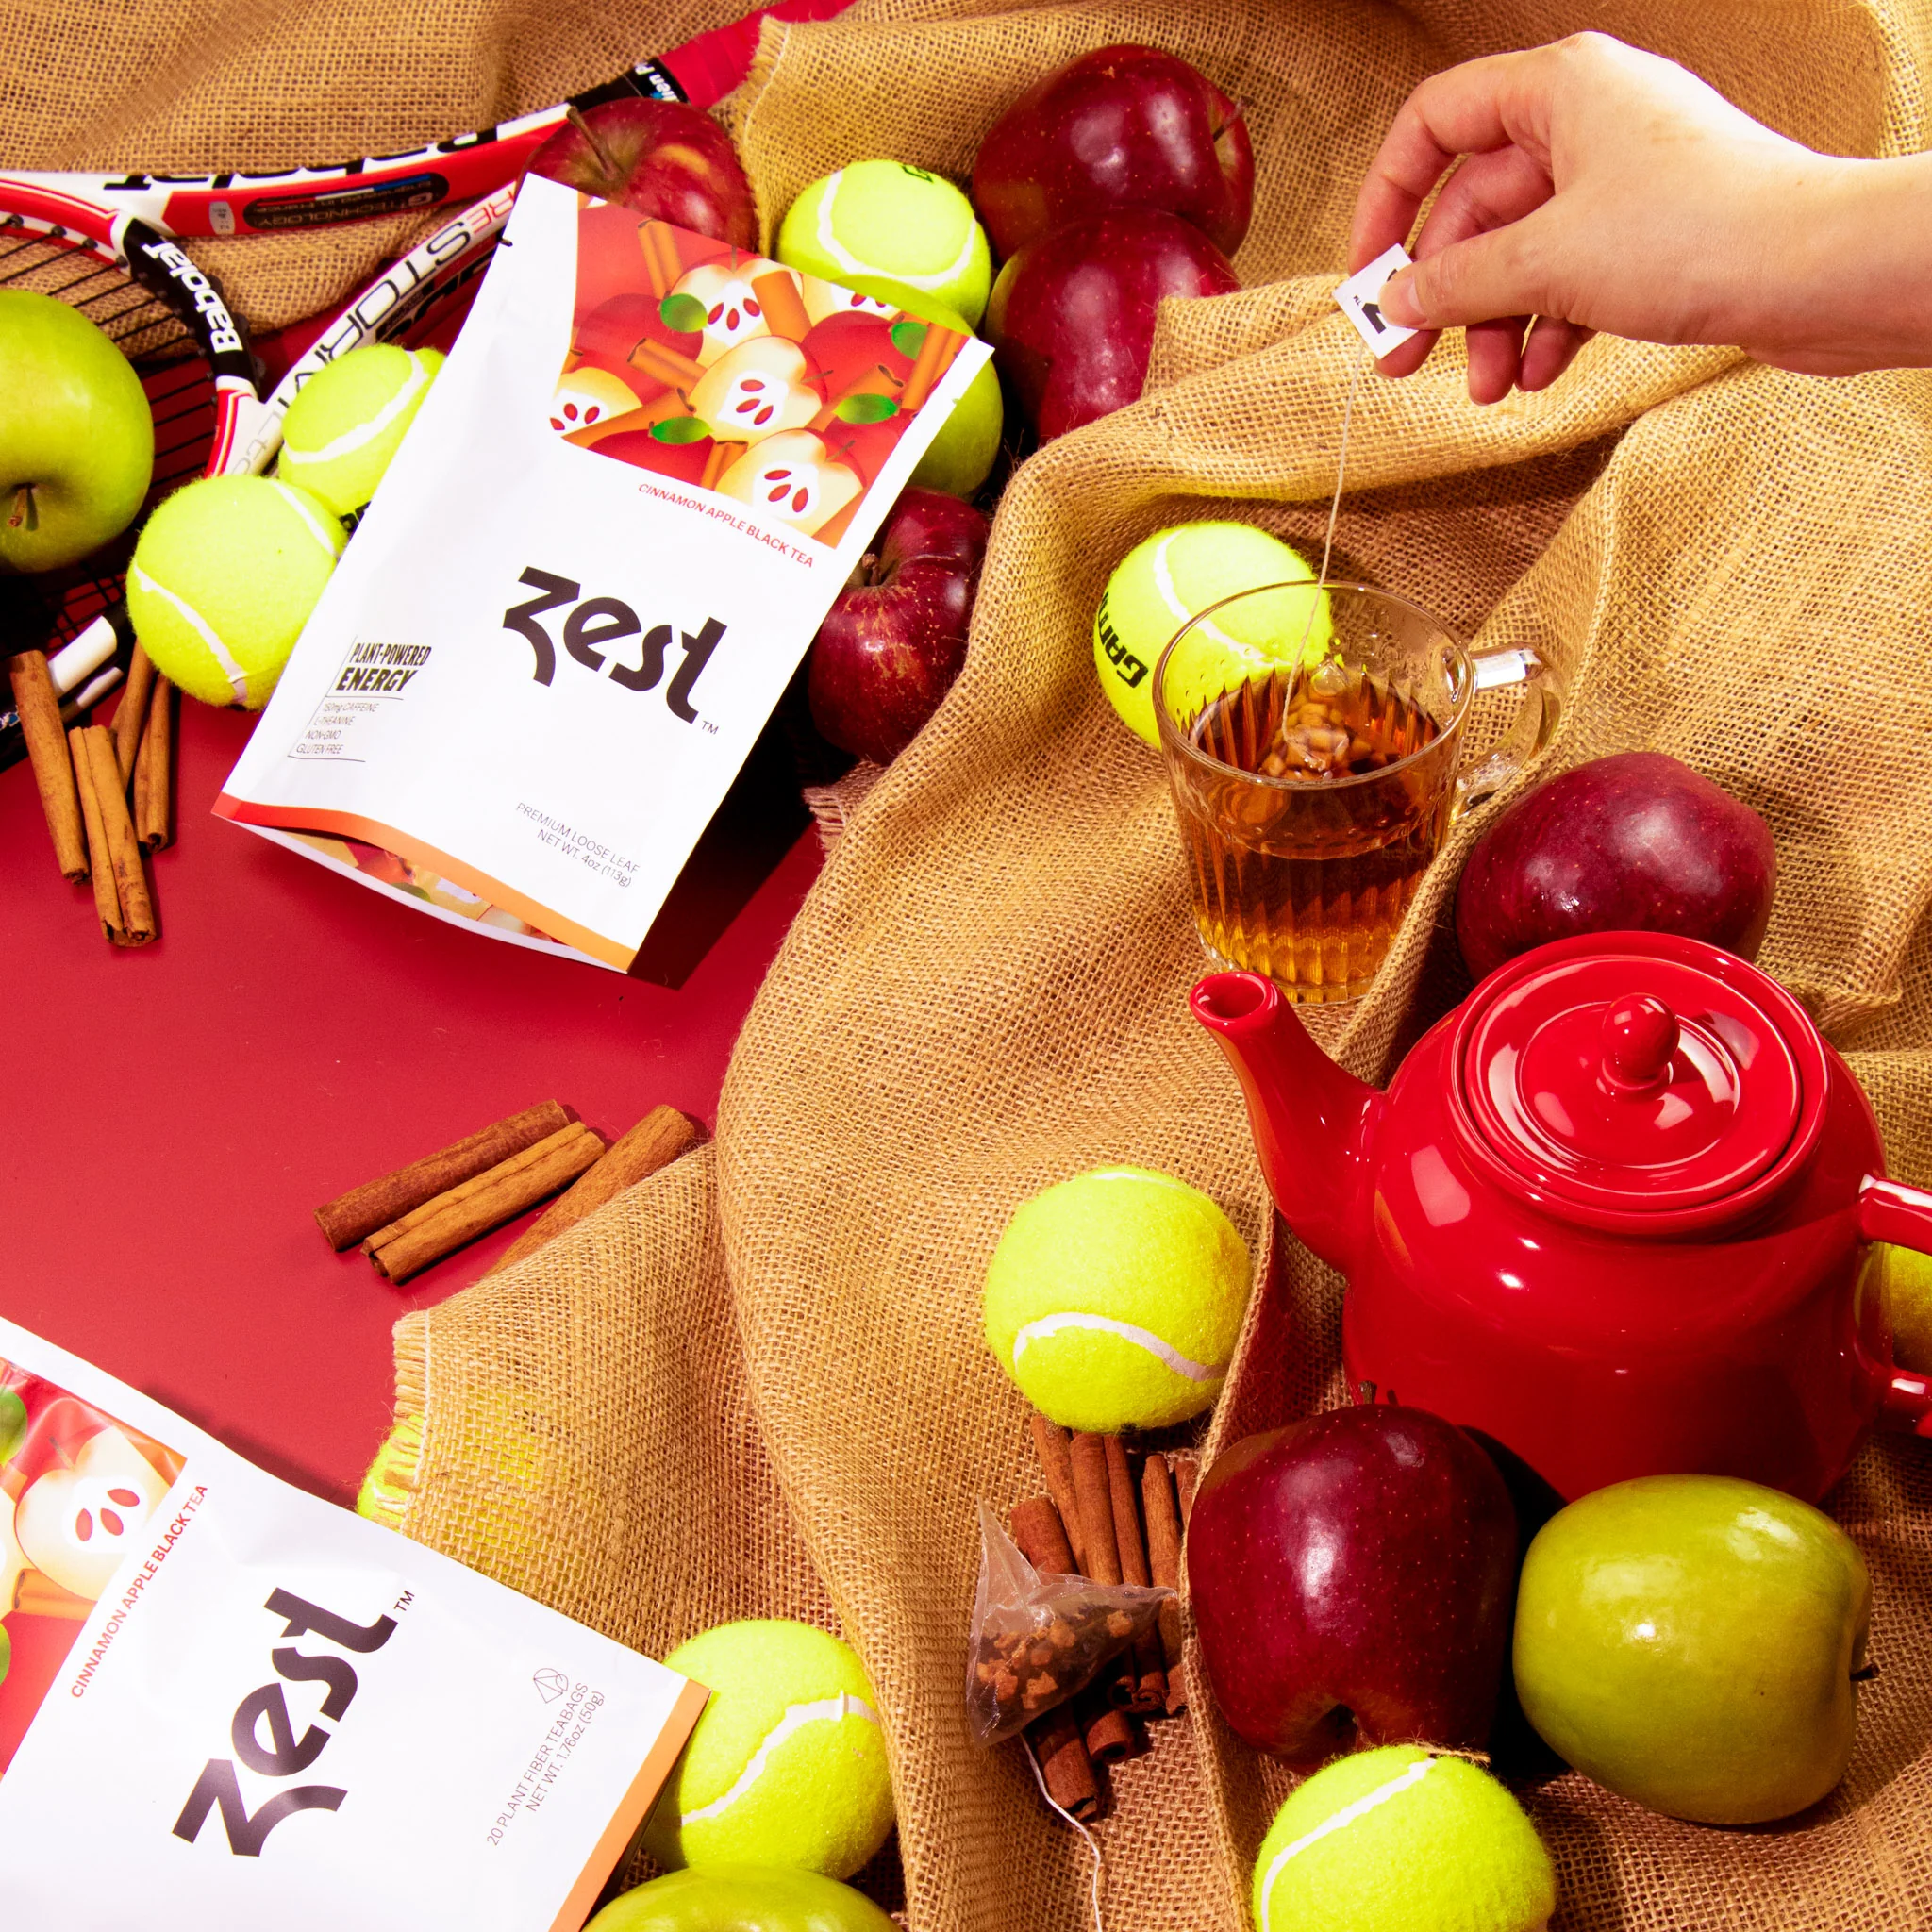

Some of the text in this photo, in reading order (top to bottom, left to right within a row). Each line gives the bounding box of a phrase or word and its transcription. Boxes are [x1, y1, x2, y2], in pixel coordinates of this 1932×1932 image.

[257, 201, 400, 227] TECHNOLOGY
[142, 242, 244, 354] Babolat
[638, 483, 814, 568] CINNAMON APPLE BLACK TEA
[335, 666, 419, 691] ENERGY
[342, 702, 380, 713] CAFFEINE
[295, 743, 344, 756] GLUTEN FREE
[305, 729, 342, 741] NON-GMO
[515, 802, 641, 874] PREMIUM LOOSE LEAF
[537, 829, 633, 889] NET WT. 4oz (113g)
[71, 1484, 208, 1698] CINNAMON APPLE BLACK TEA
[486, 1682, 589, 1846] 20 PLANT FIBER TEABAGS
[525, 1690, 606, 1812] NET WT. 1.76oz (50g)
